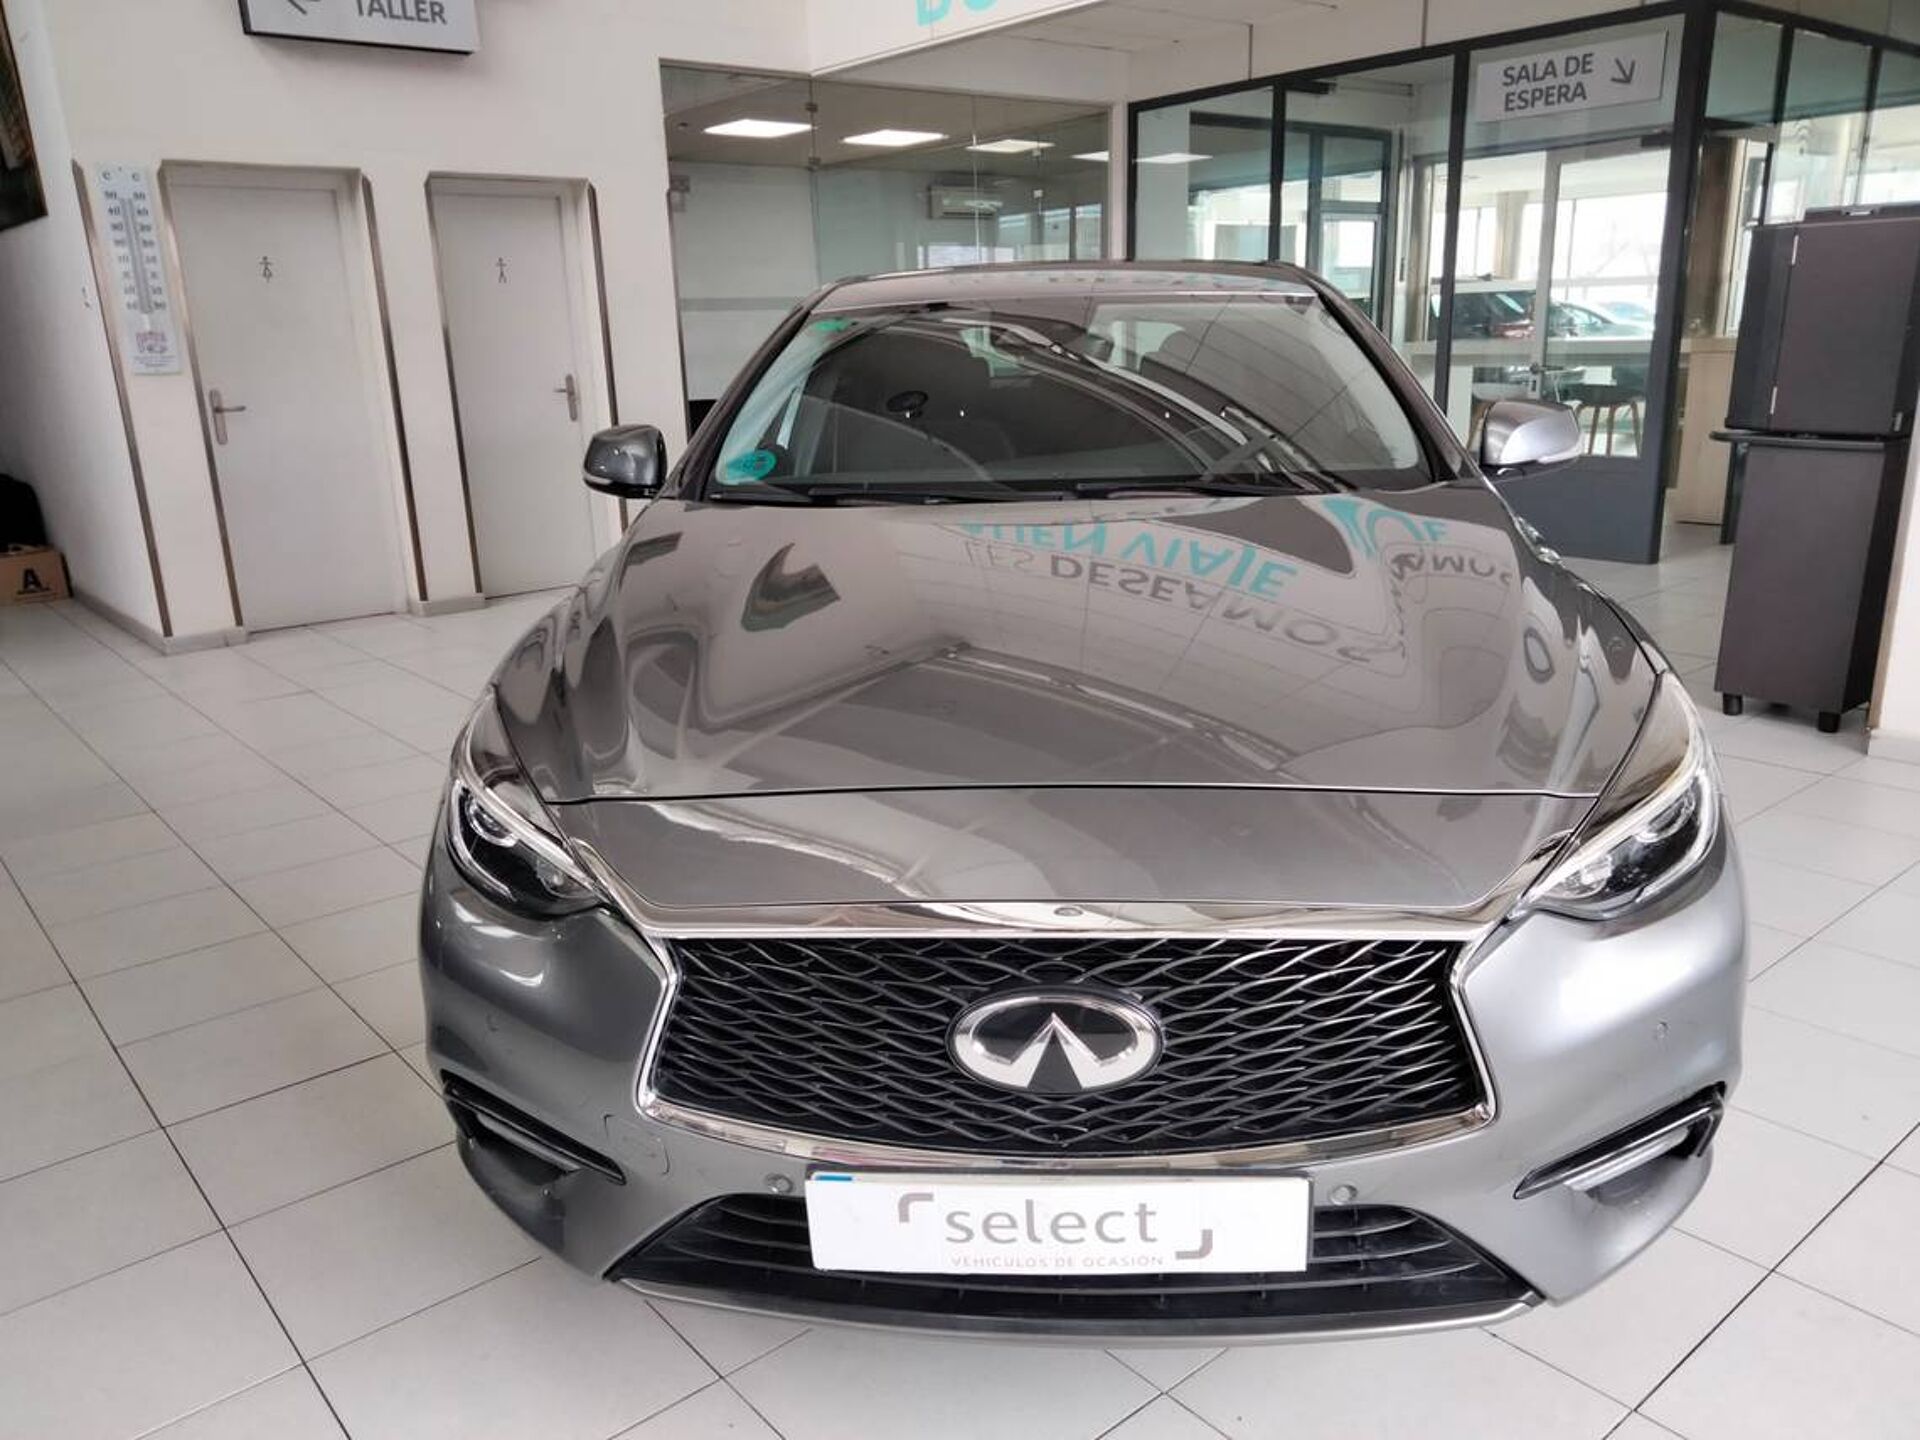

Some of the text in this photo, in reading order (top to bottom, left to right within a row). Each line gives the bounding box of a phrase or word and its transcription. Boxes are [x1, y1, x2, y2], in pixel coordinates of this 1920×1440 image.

[1502, 52, 1595, 87] SALA DE
[1504, 81, 1588, 113] ESPERA
[22, 567, 44, 591] A
[945, 1198, 1159, 1245] select
[951, 1255, 1049, 1269] VEHICULOS
[1055, 1256, 1077, 1268] DE
